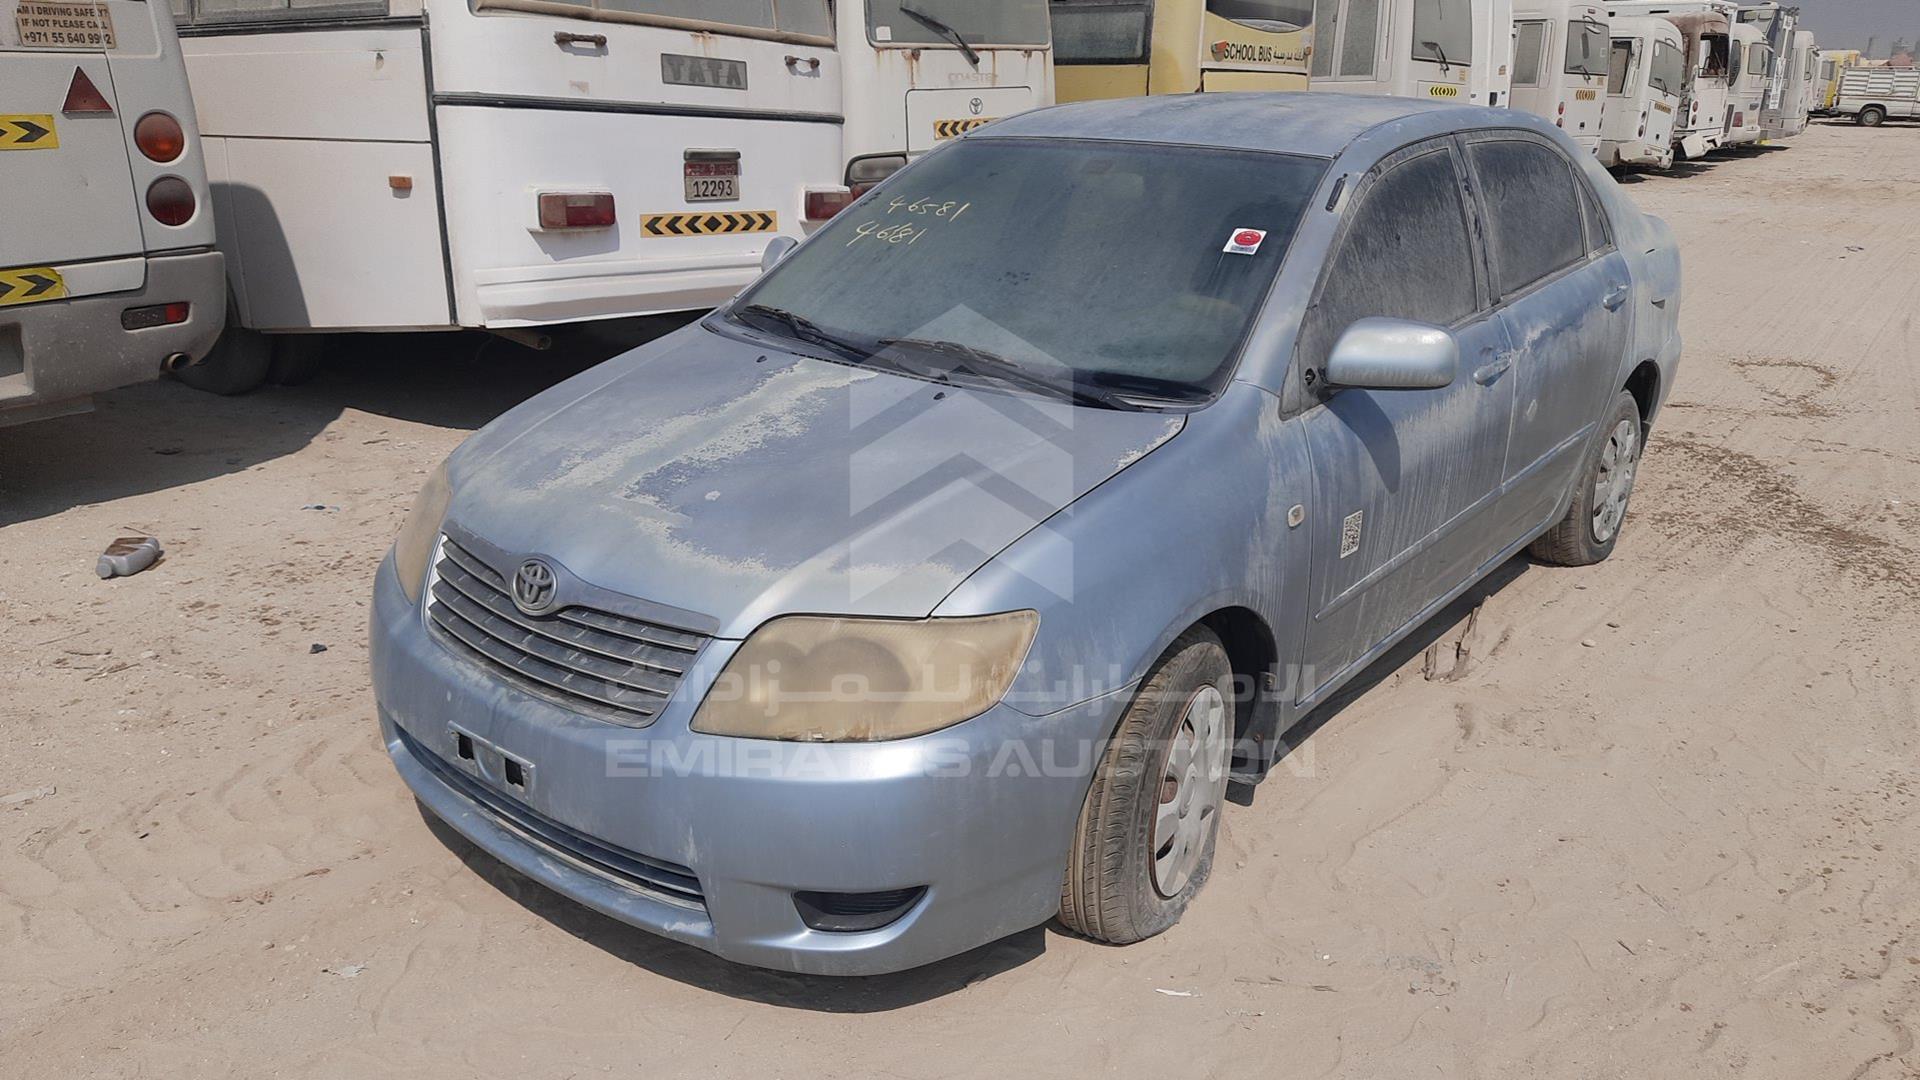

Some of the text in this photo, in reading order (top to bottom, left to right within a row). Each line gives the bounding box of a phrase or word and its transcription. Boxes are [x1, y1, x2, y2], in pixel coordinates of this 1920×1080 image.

[31, 6, 35, 15] I
[37, 6, 72, 17] DRIVING
[74, 8, 110, 18] SAFEY?
[21, 18, 30, 27] IF
[32, 18, 50, 28] NOT
[53, 20, 85, 29] PLEASE
[24, 31, 112, 45] +971 55 640 992
[1223, 42, 1273, 62] SCHOOL BUS
[666, 58, 742, 86] TATA
[692, 179, 733, 198] 12293
[887, 195, 971, 223] 46581
